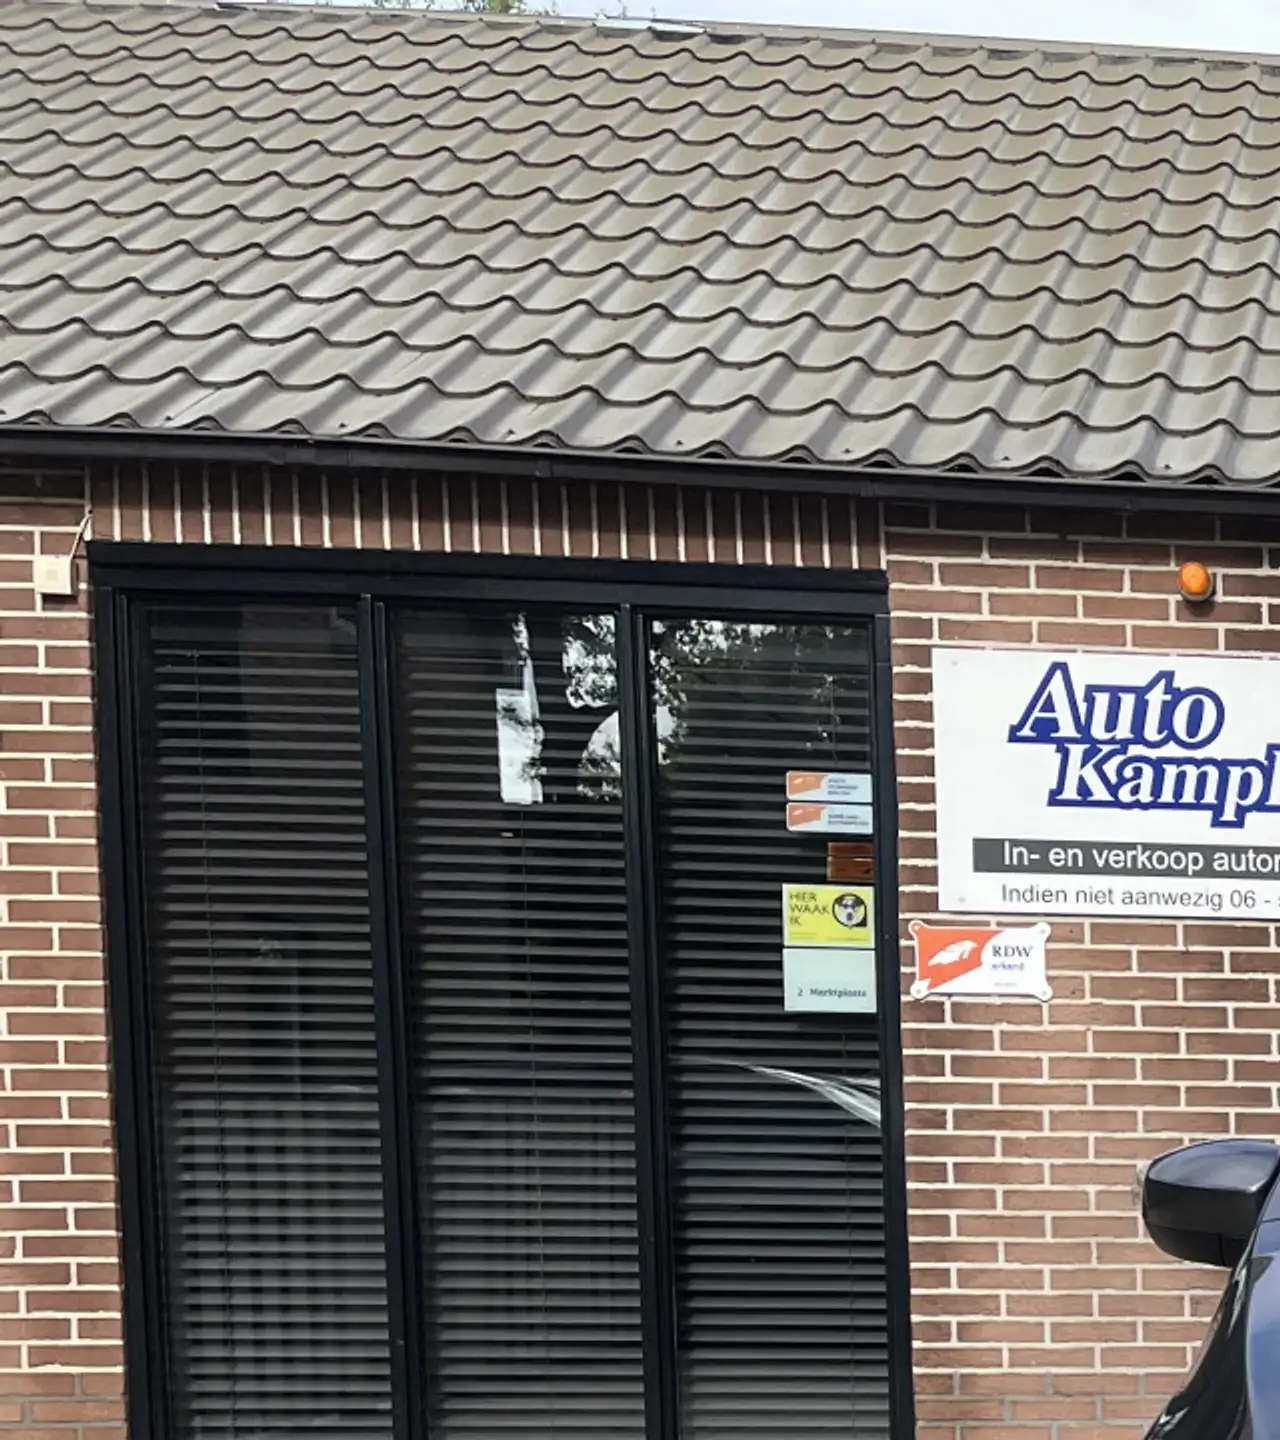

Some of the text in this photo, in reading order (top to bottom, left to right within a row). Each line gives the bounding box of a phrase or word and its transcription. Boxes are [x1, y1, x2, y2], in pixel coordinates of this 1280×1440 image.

[1008, 661, 1224, 749] Auto
[1004, 840, 1041, 866] In-
[1048, 847, 1084, 867] en
[1092, 844, 1204, 875] verkoop
[789, 891, 817, 902] HIER
[1002, 884, 1067, 903] Indien
[1076, 886, 1114, 905] niet
[1121, 889, 1223, 911] aanwezig
[1230, 890, 1256, 908] 06
[789, 903, 830, 914] WAAK
[992, 944, 1034, 957] RDW
